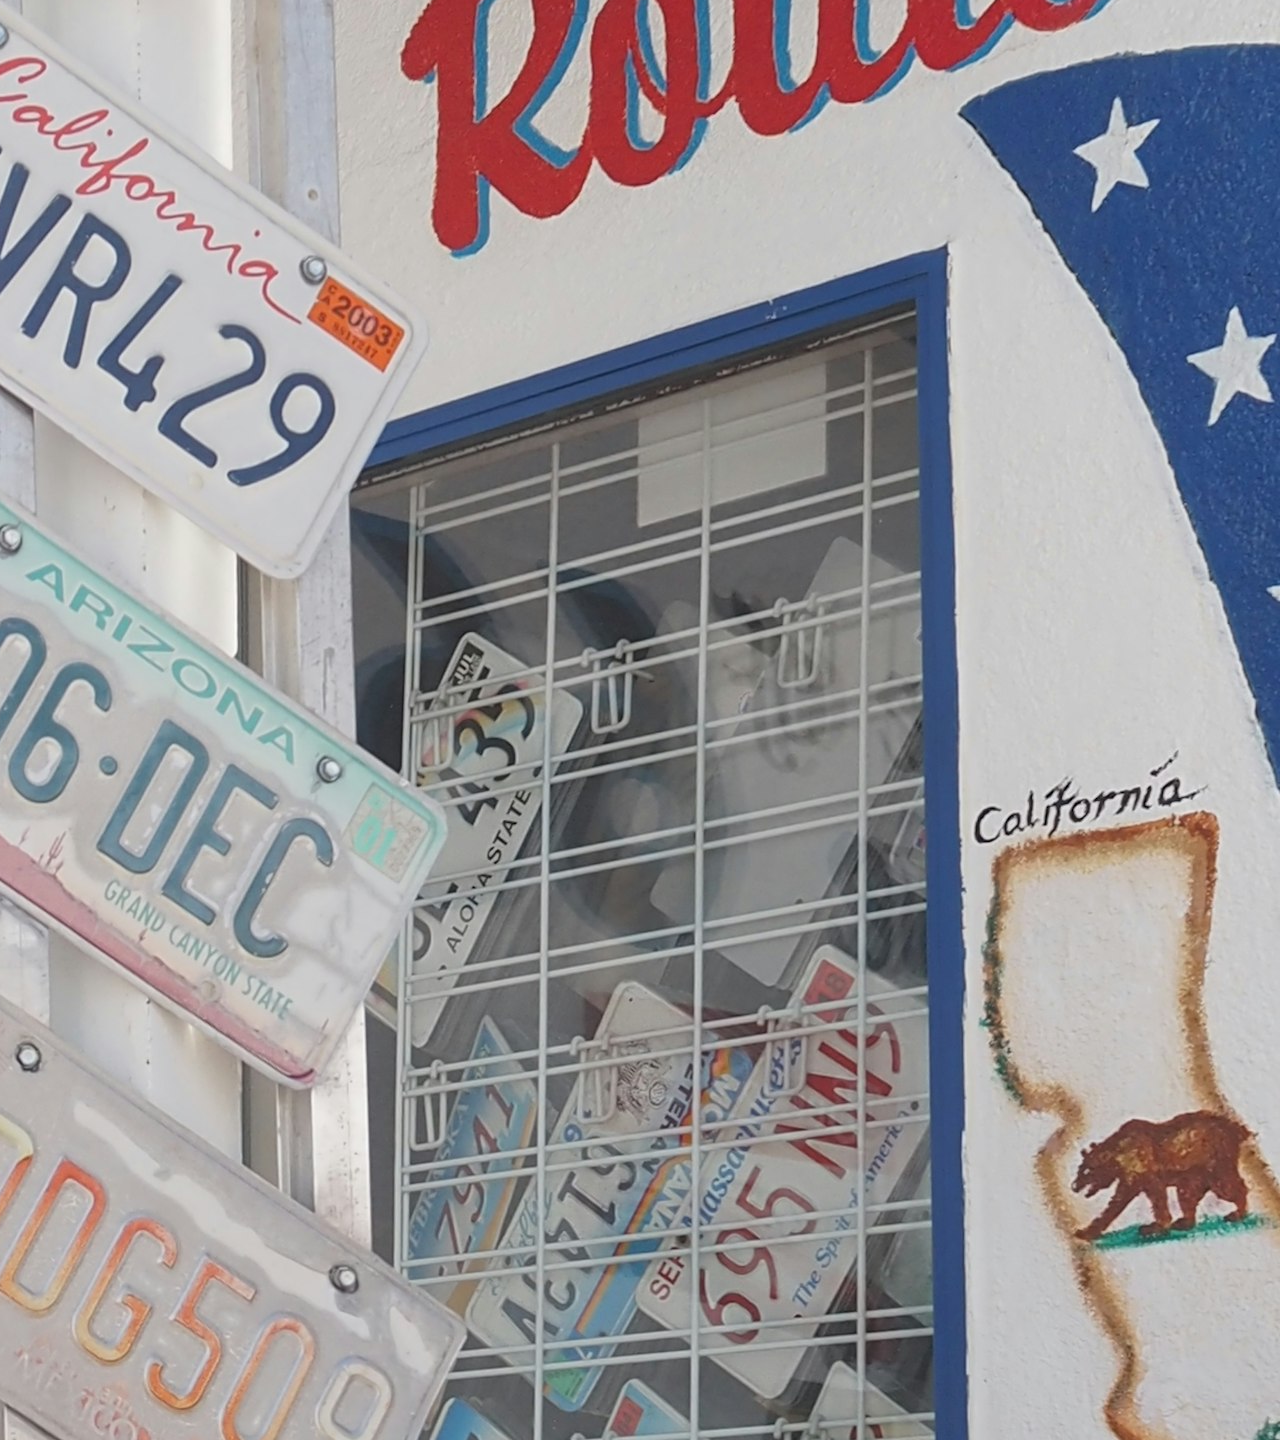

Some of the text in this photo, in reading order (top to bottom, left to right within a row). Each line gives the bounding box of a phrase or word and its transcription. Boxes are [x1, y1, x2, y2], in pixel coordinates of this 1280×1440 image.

[331, 295, 393, 347] 2003
[25, 563, 296, 764] ARIZONA
[487, 789, 530, 866] STATE
[974, 751, 1208, 845] California
[104, 879, 294, 1021] GRAND CANYON STATE
[792, 1273, 823, 1308] The
